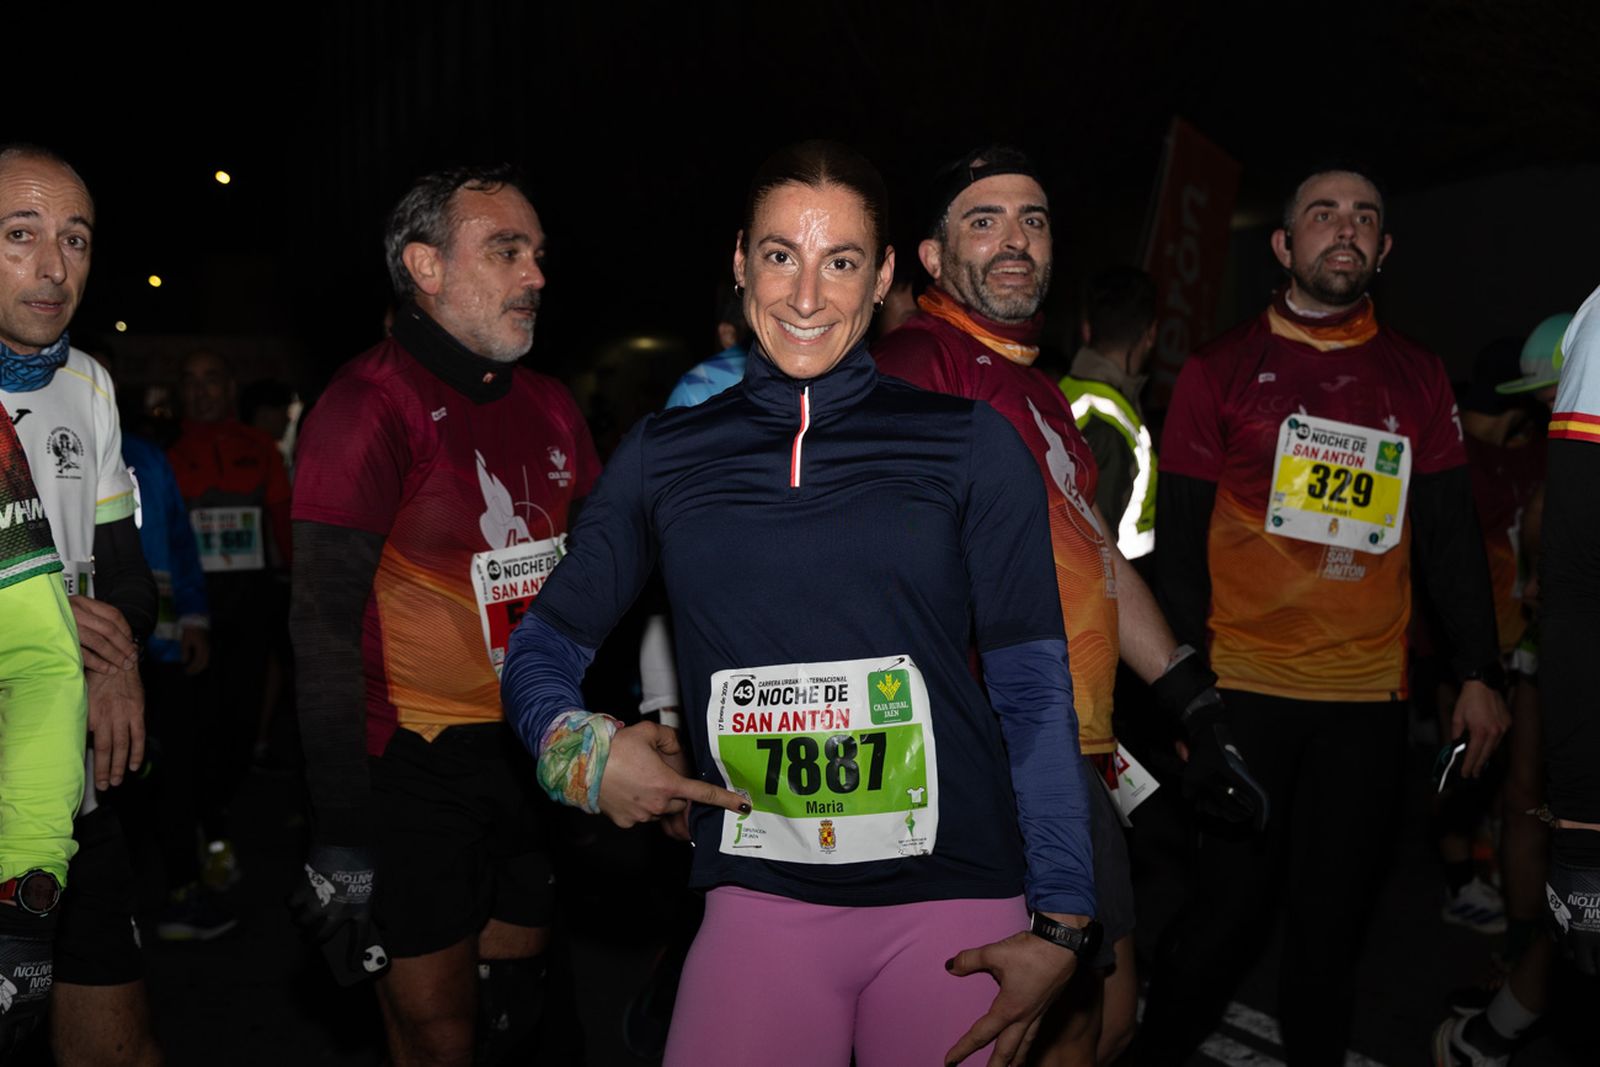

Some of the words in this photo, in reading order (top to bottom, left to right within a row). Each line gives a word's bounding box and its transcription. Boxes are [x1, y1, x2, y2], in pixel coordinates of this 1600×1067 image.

[1311, 431, 1349, 451] NOCHE
[1351, 440, 1367, 453] DE
[1293, 444, 1320, 459] SAN
[1307, 464, 1374, 508] 329
[503, 559, 544, 579] NOCHE
[492, 582, 518, 600] SAN
[734, 685, 754, 699] 43
[758, 680, 781, 688] CARRERA
[757, 686, 819, 706] NOCHE
[824, 684, 849, 702] DE
[732, 711, 773, 733] SAN
[777, 703, 850, 732] ANTÓN
[756, 732, 887, 796] 7887
[806, 800, 844, 814] Maria
[346, 882, 373, 894] SAN
[30, 975, 53, 988] SAN
